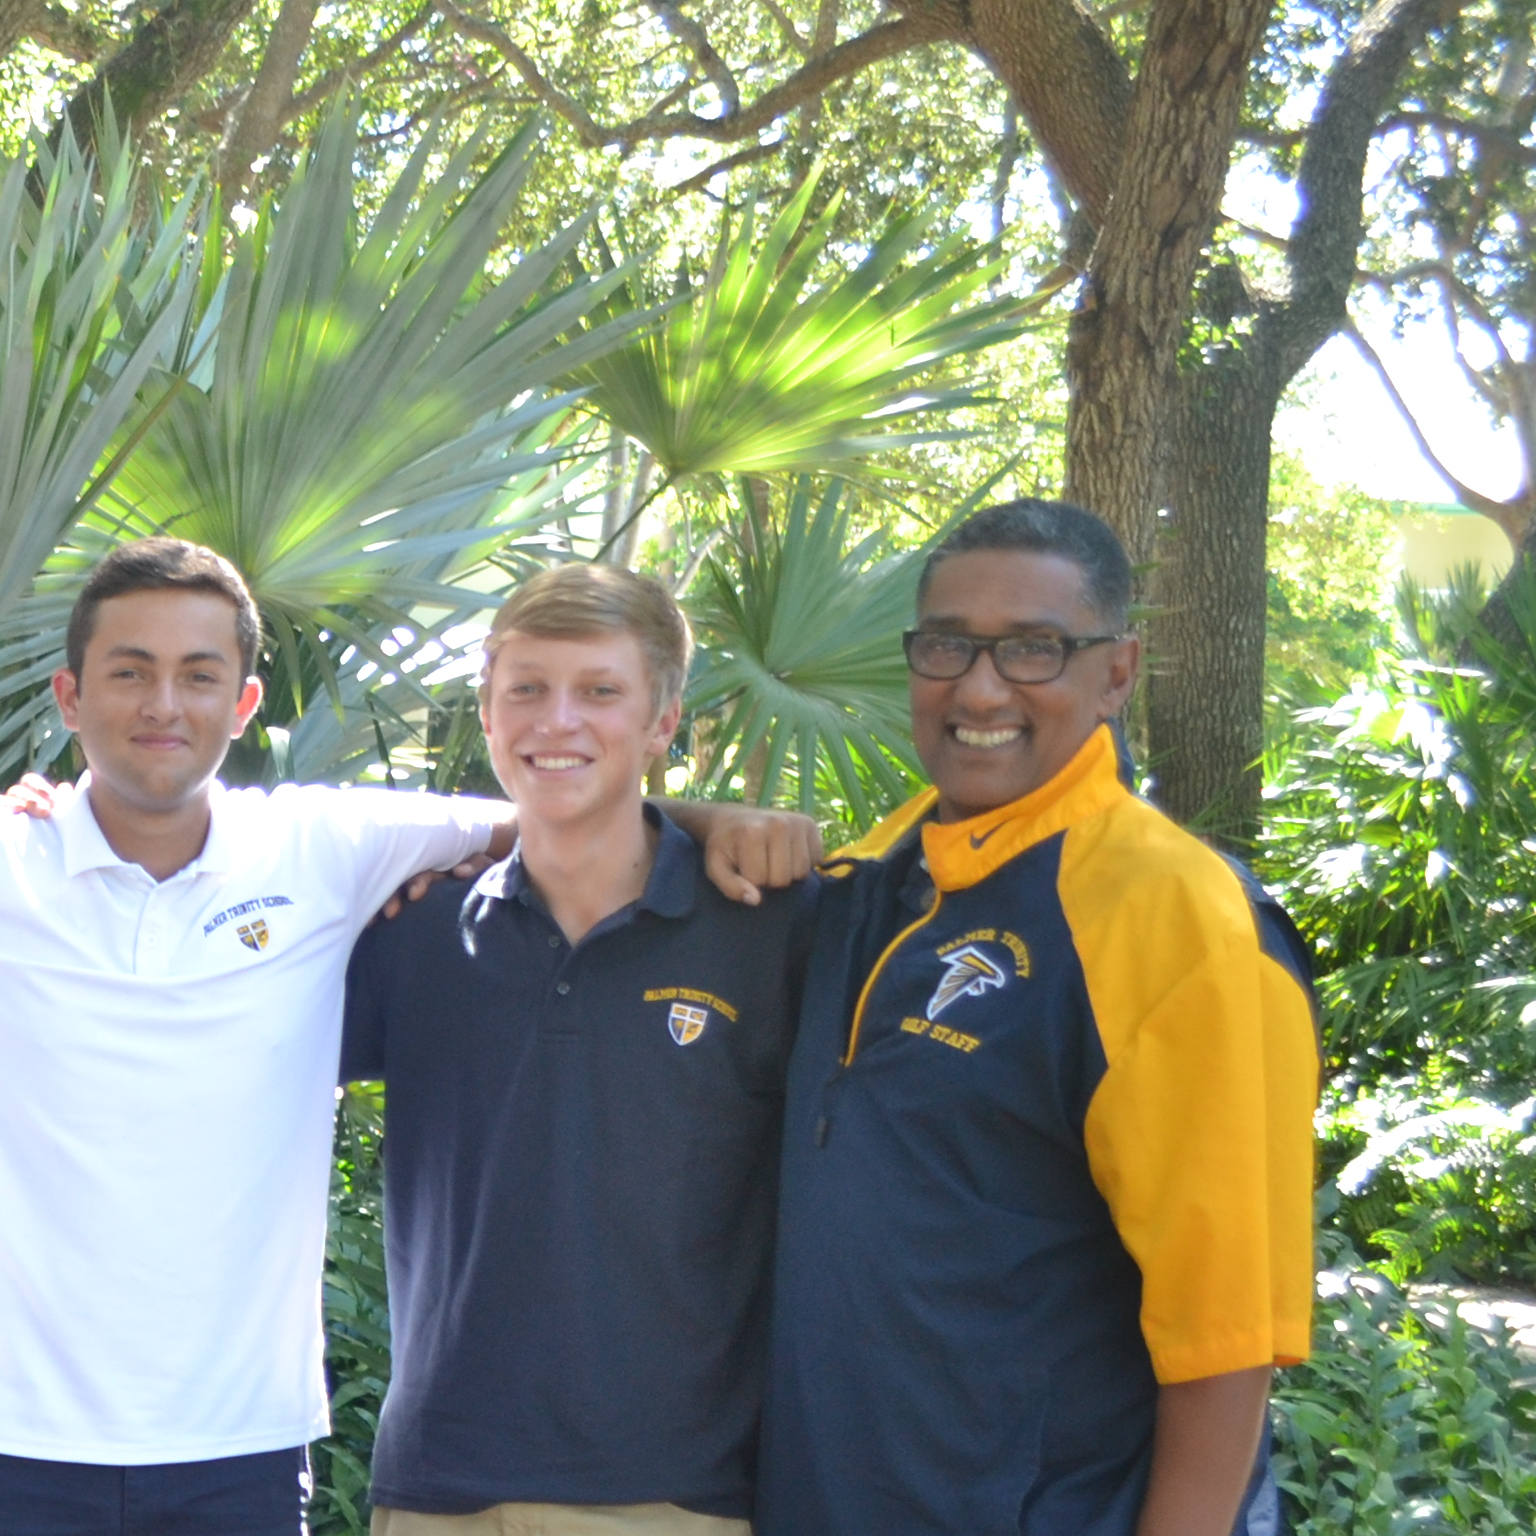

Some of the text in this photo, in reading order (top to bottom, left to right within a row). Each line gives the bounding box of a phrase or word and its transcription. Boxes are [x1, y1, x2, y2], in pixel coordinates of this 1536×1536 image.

[226, 898, 262, 920] TRINITY
[935, 928, 1031, 979] PALMER TRINITY
[929, 1024, 981, 1053] STAFF
